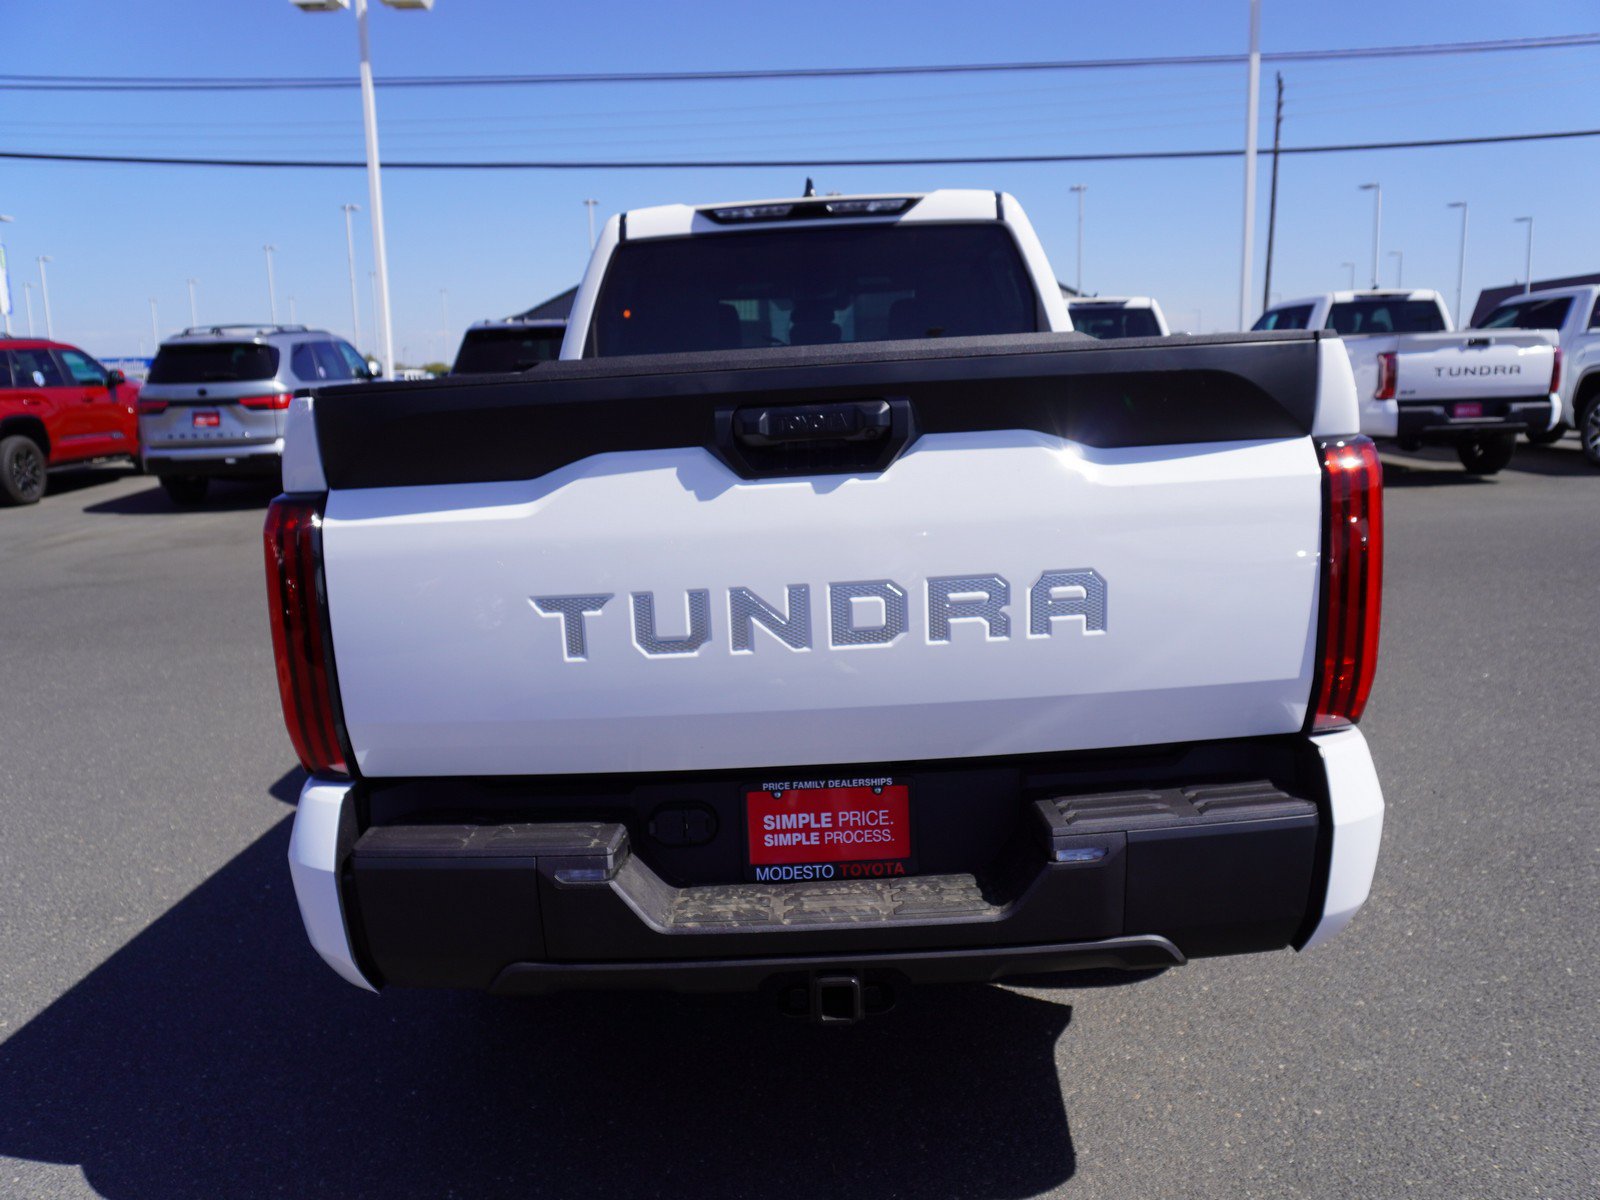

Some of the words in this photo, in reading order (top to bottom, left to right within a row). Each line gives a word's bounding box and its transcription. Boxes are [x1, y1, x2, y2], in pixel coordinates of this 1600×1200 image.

[1434, 365, 1521, 377] TUNDRA
[527, 567, 1109, 662] TUNDRA
[762, 782, 790, 791] PRICE
[793, 780, 826, 790] FAMILY
[828, 777, 893, 788] DEALERSHIPS
[763, 812, 833, 830] SIMPLE
[837, 809, 894, 827] PRICE.
[764, 832, 820, 847] SIMPLE
[824, 829, 895, 844] PROCESS.
[756, 864, 834, 881] MODESTO
[840, 861, 905, 877] TOYOTA
